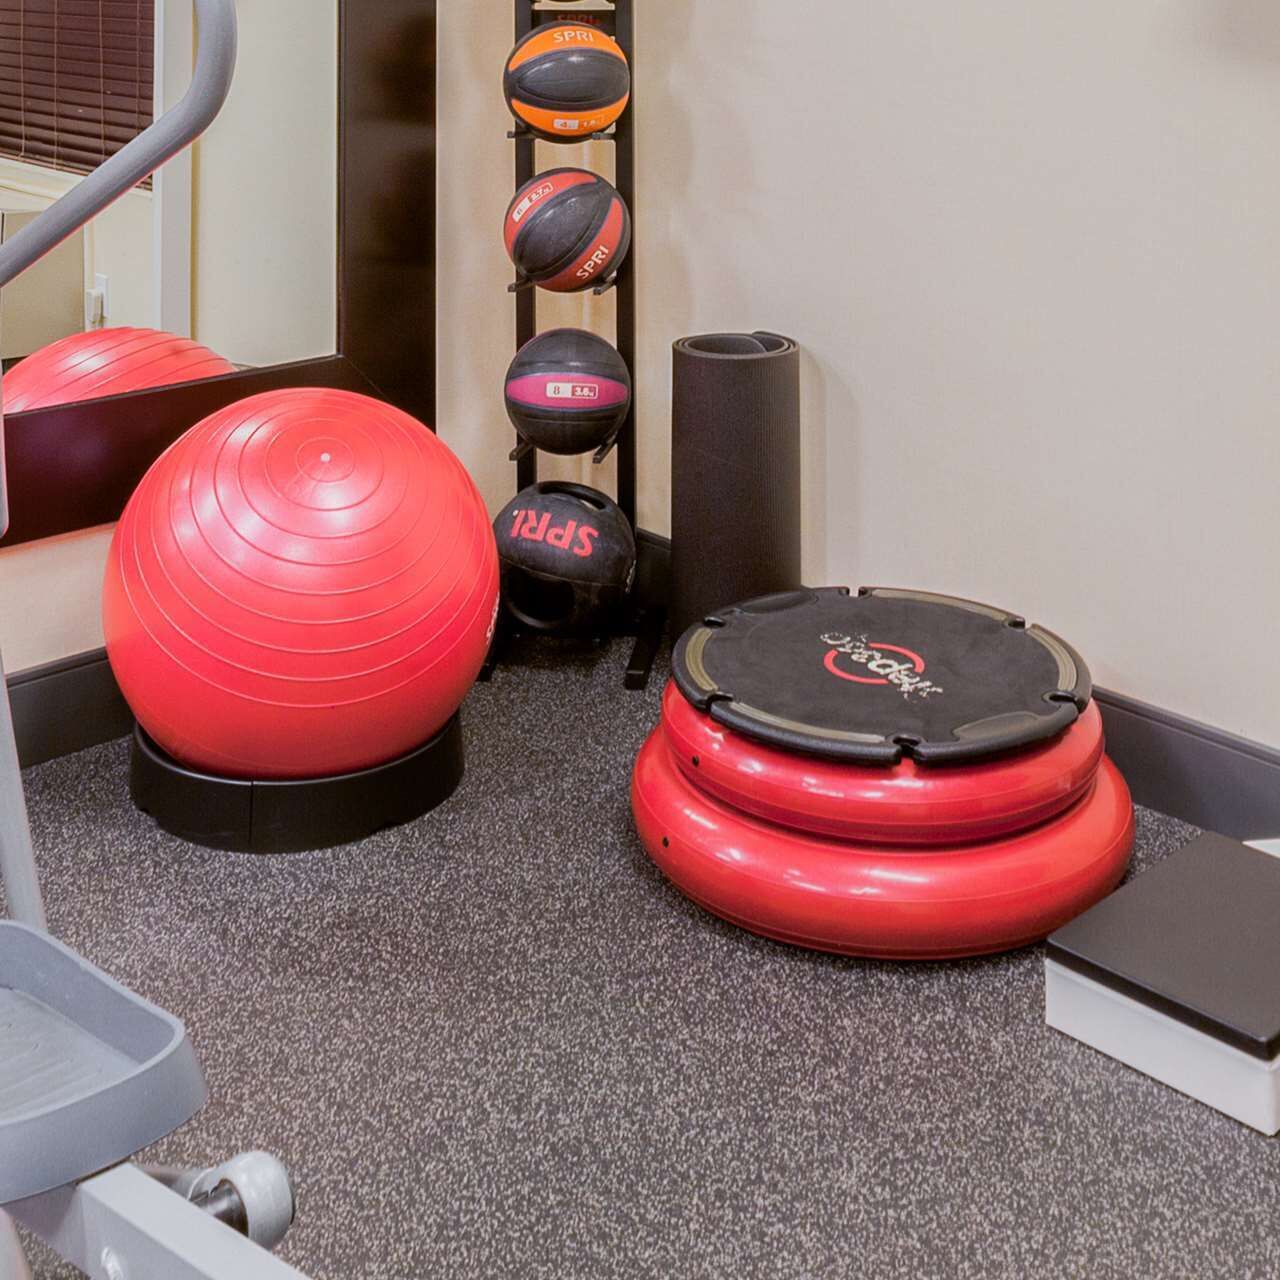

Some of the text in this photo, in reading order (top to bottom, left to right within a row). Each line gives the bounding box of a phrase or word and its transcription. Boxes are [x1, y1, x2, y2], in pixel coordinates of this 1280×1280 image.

[552, 30, 594, 44] SPRI
[575, 244, 609, 279] SPRI
[553, 384, 561, 395] 8
[511, 509, 598, 557] SPRI
